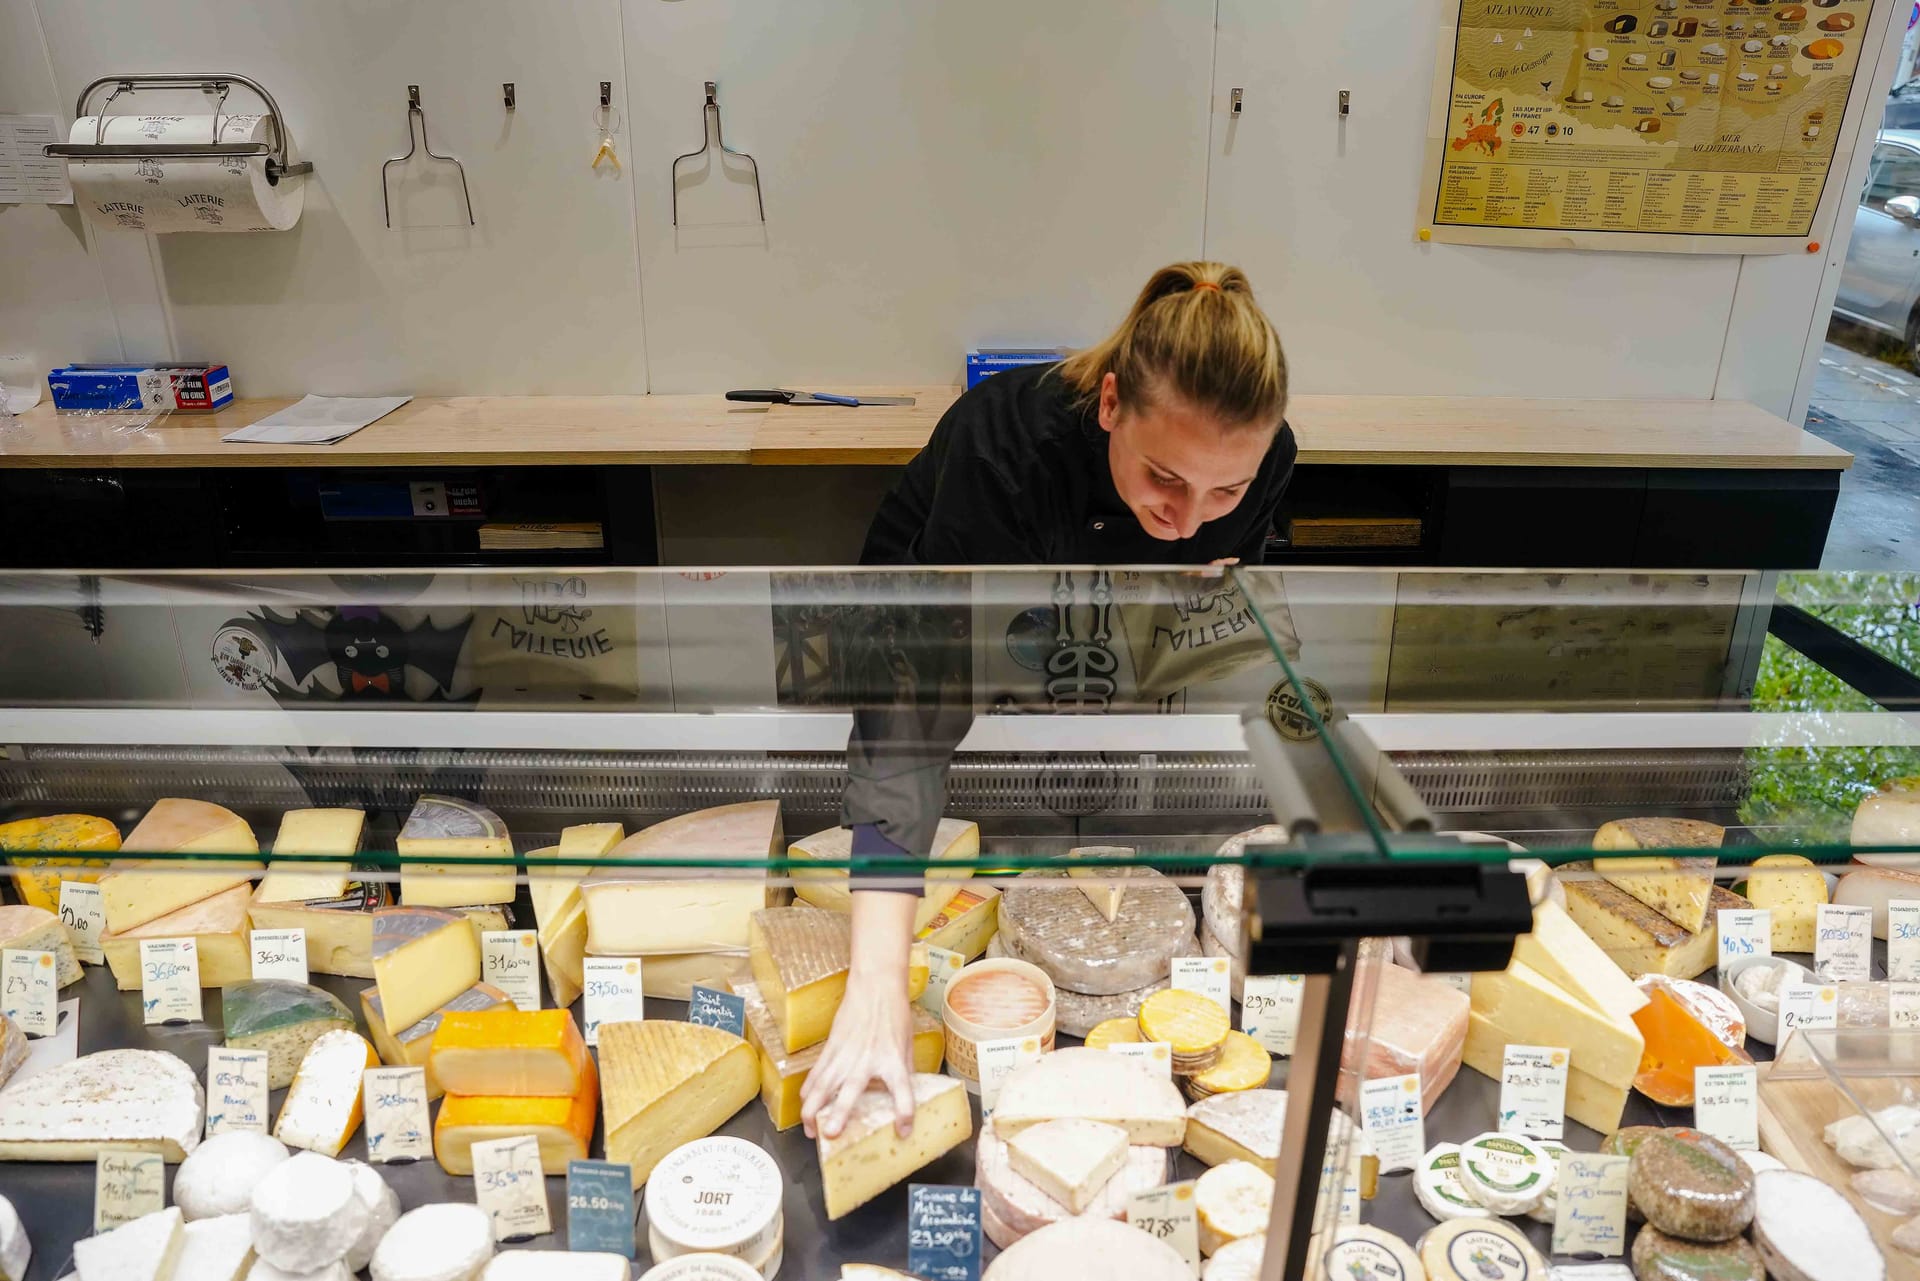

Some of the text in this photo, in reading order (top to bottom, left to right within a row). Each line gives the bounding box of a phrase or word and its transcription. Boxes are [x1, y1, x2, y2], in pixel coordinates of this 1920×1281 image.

[1484, 5, 1553, 17] ATLANTIQUE
[1527, 126, 1540, 135] 47
[1562, 127, 1573, 136] 10
[177, 193, 225, 208] LAITERIE
[97, 200, 145, 215] LAITERIE
[693, 1192, 734, 1205] JORT
